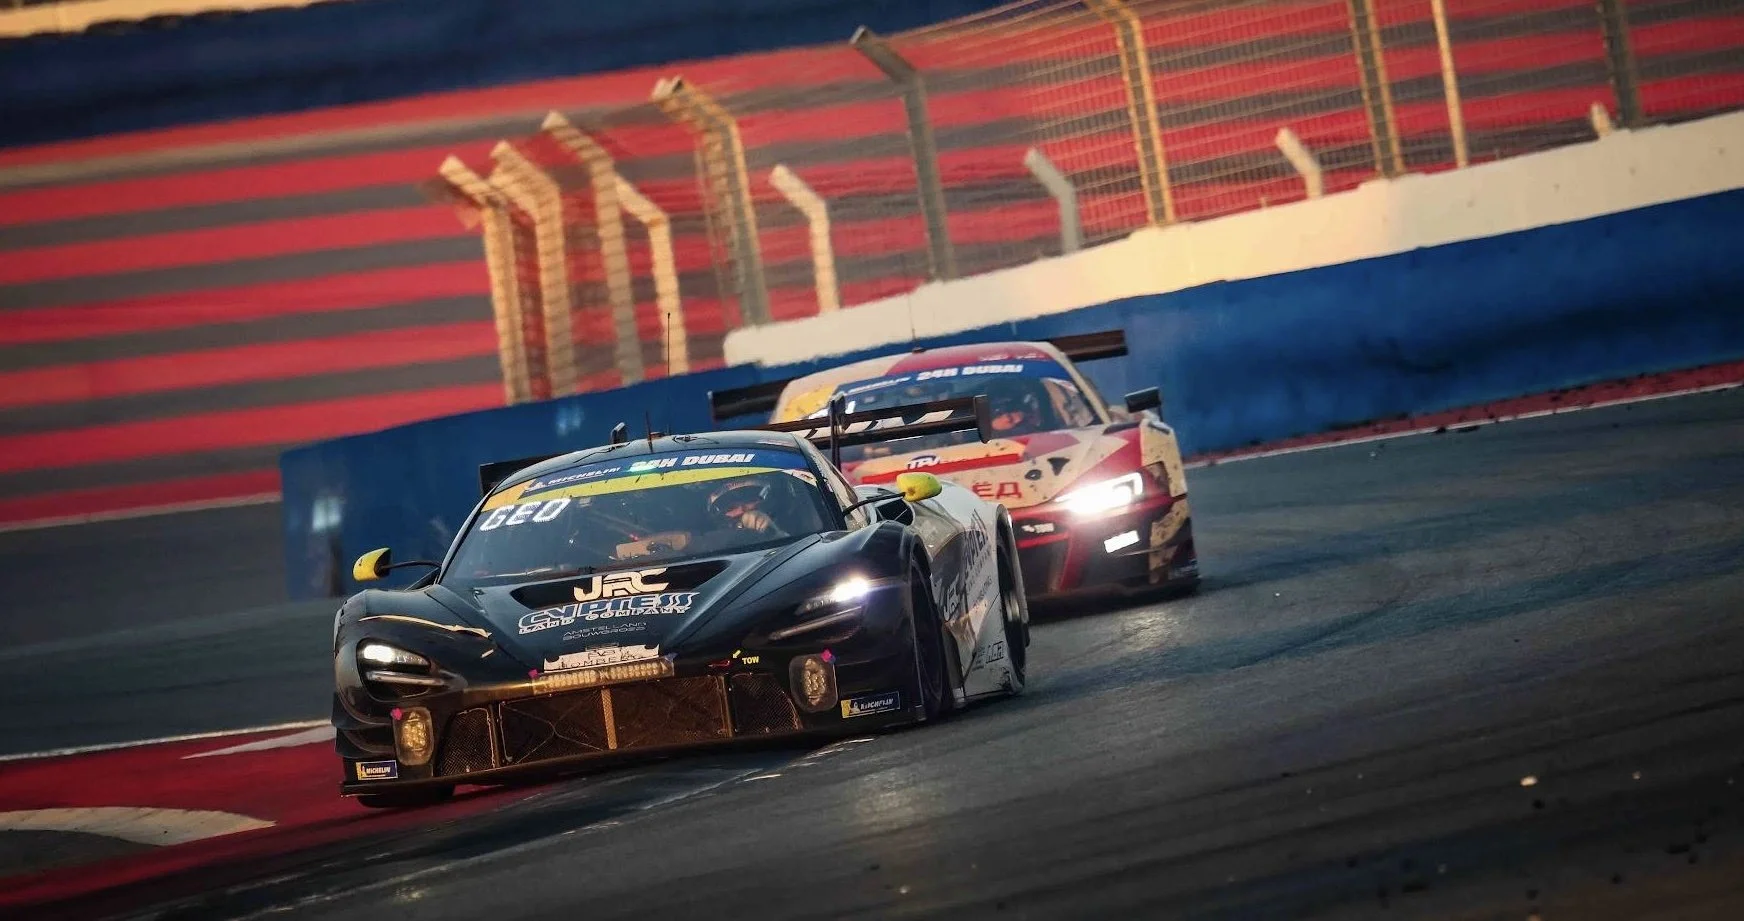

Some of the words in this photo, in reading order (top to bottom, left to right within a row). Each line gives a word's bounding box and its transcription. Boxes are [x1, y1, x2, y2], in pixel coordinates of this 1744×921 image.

[962, 364, 1024, 376] DUBAI
[547, 466, 621, 486] MICHELIN
[681, 453, 756, 467] DUBAI
[573, 567, 669, 602] JRC
[518, 617, 575, 635] LAND
[585, 605, 690, 622] COMPANY
[742, 655, 760, 665] TOW
[366, 766, 391, 775] MICHELIN
